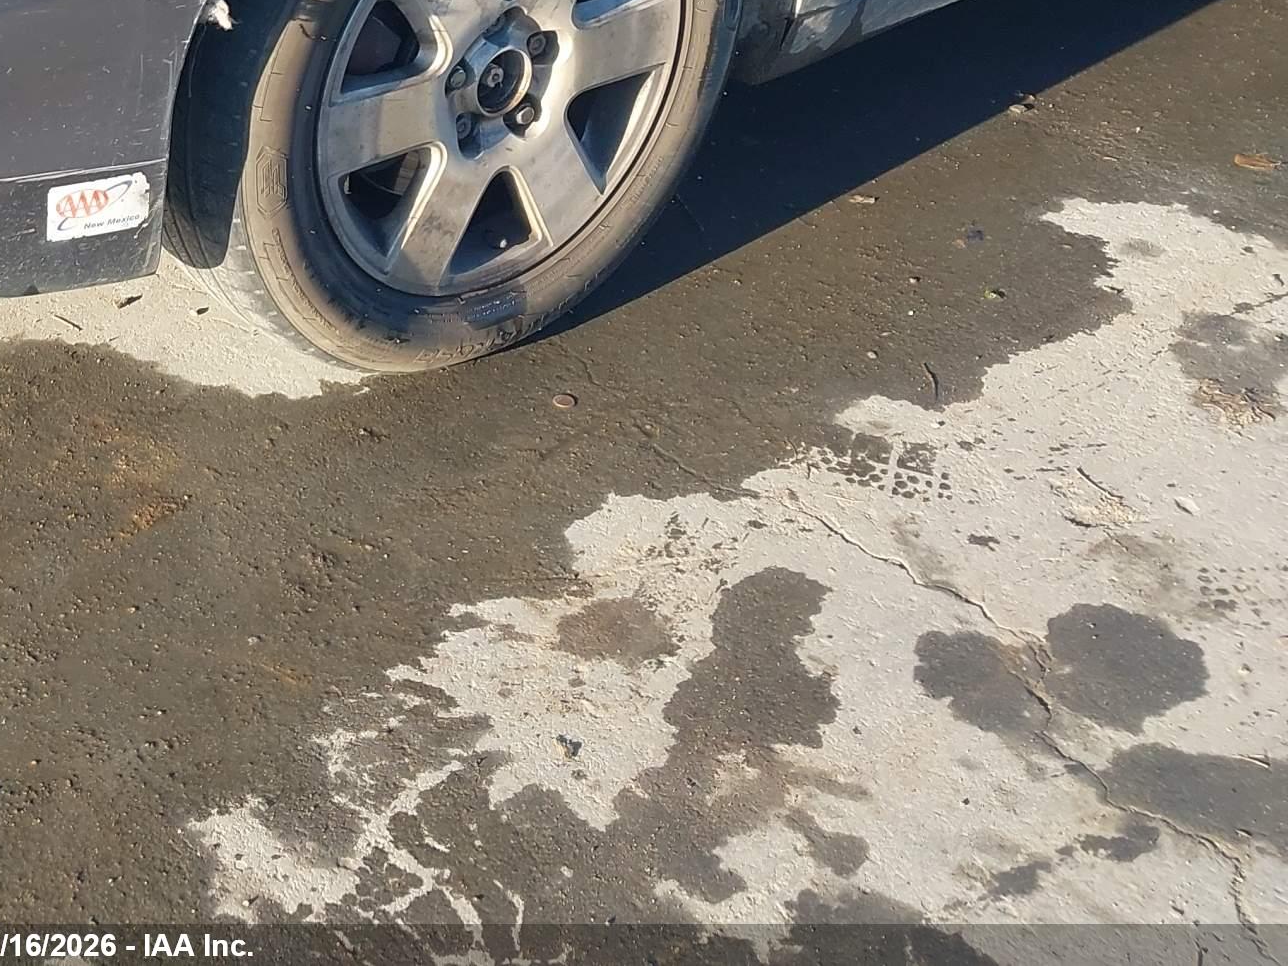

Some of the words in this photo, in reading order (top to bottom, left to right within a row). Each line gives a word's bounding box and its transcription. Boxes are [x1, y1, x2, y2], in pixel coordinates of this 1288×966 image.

[56, 188, 109, 218] AAA
[83, 220, 105, 230] New
[107, 214, 141, 226] Mexico
